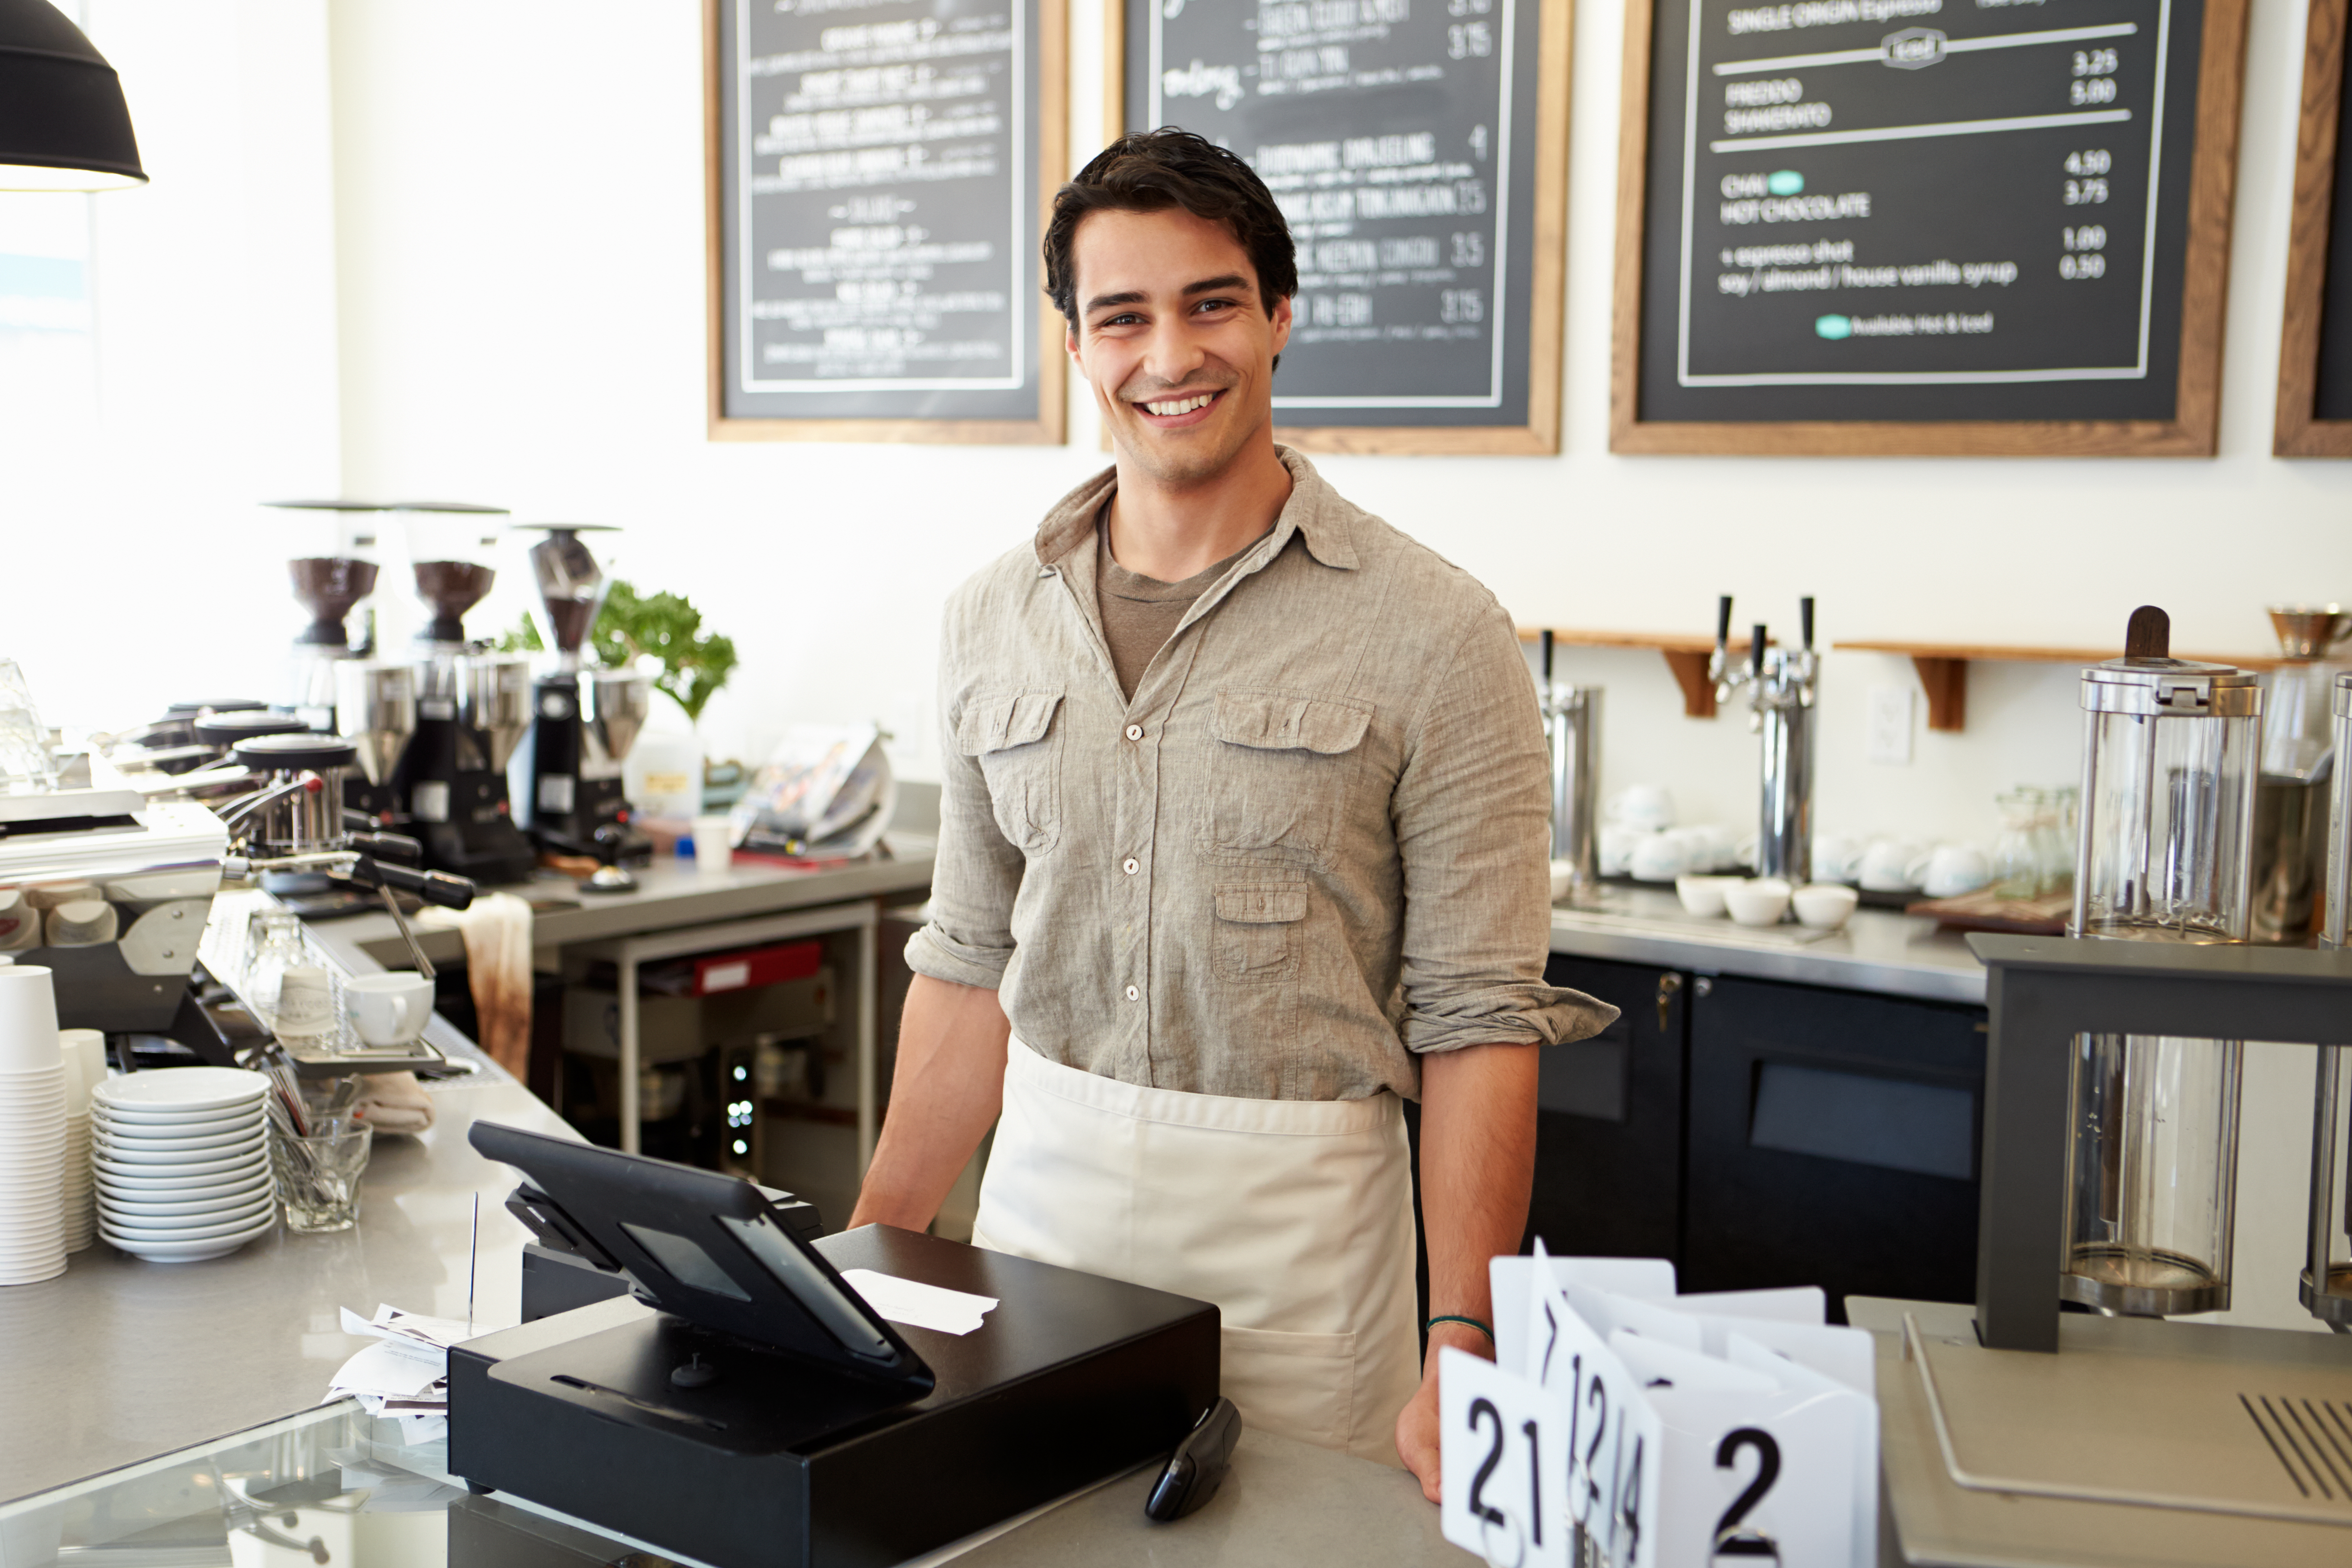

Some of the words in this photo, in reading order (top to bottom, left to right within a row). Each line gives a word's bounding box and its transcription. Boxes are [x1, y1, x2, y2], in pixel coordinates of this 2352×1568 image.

[1728, 5, 1793, 34] SINGLE
[1725, 78, 1803, 108] FREDDO
[2071, 48, 2118, 76] 3.25
[1468, 124, 1487, 162] 4
[1721, 173, 1768, 198] CHAI
[2064, 149, 2111, 176] 4.50
[1720, 199, 1759, 225] HOT
[1760, 192, 1871, 223] CHOCOLATE
[2063, 178, 2109, 205] 3.75
[1735, 243, 1812, 269] espresso
[1812, 238, 1854, 263] shot
[2062, 225, 2107, 251] 1.00
[1718, 273, 1748, 297] soy
[1761, 264, 1831, 292] almond
[1842, 264, 1898, 288] house
[1898, 259, 1961, 286] vanilla
[1962, 261, 2018, 288] syrup
[2059, 253, 2106, 279] 0.50
[1958, 311, 1993, 333] Iced
[1468, 1398, 1541, 1546] 21
[1715, 1427, 1780, 1555] 2
